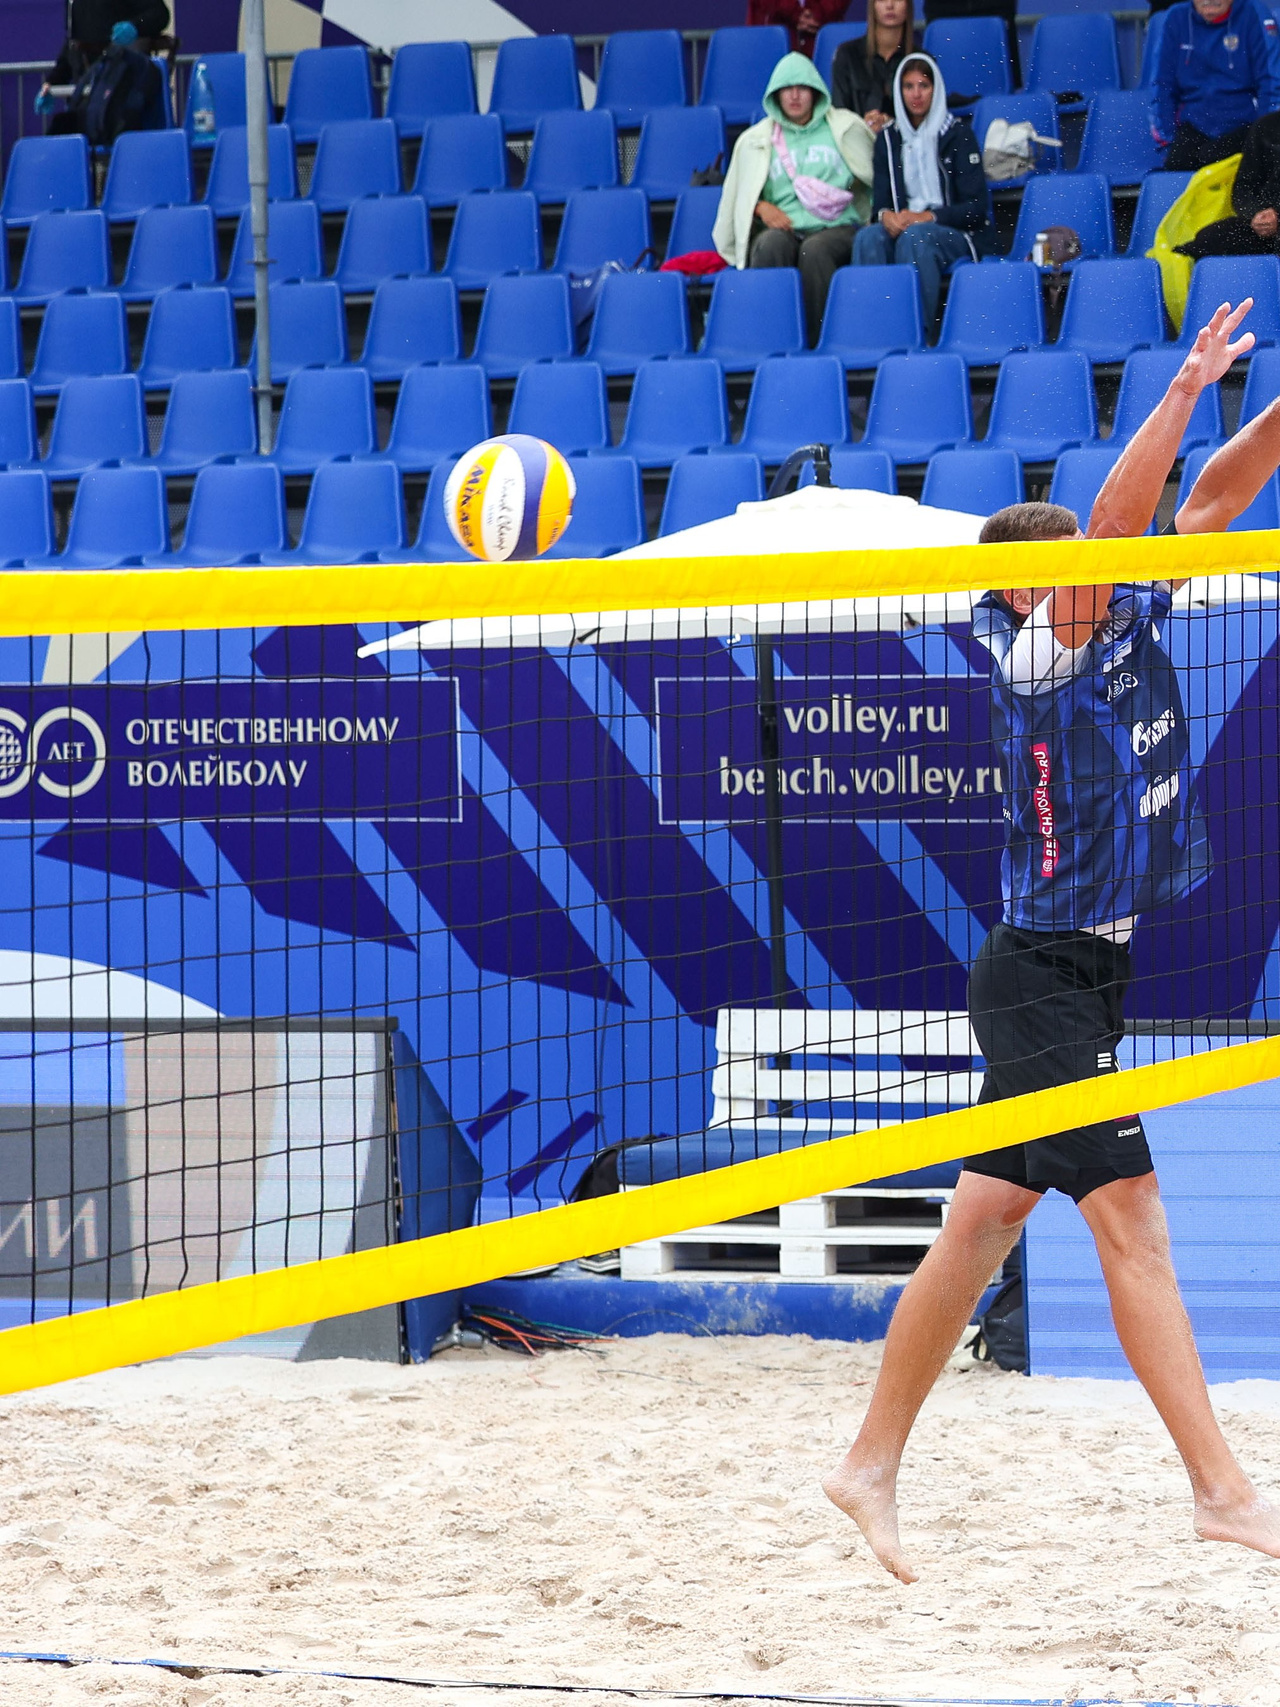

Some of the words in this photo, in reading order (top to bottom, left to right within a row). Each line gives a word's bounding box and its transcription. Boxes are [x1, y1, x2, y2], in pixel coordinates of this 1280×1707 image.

[125, 717, 400, 745] ОТЕЧЕСТВЕННОМУ
[784, 694, 950, 742] volley.ru
[127, 754, 308, 788] ВОЛЕЙБОЛУ
[1033, 751, 1057, 857] BECH.VOLLEY.RU
